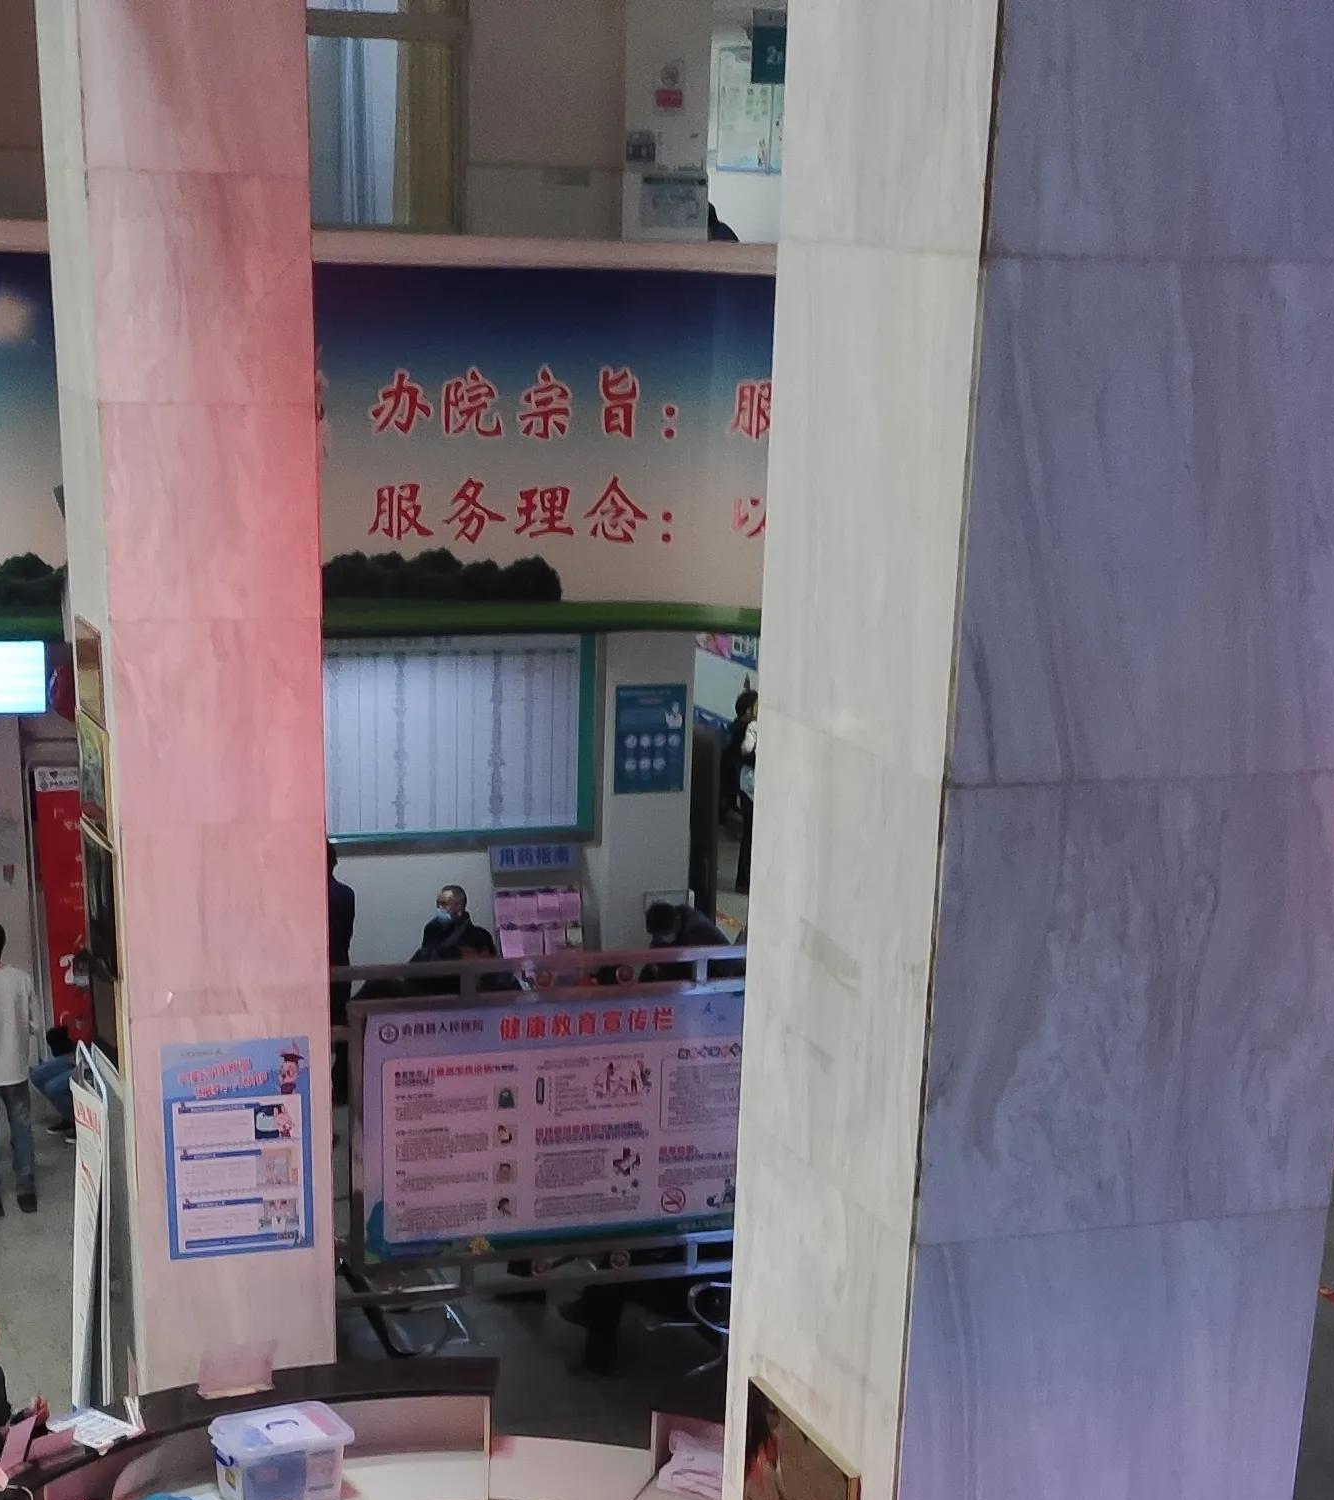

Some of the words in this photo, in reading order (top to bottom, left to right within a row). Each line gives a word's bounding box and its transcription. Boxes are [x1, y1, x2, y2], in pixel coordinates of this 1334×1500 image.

[499, 1006, 674, 1042] 健康教育宣传栏
